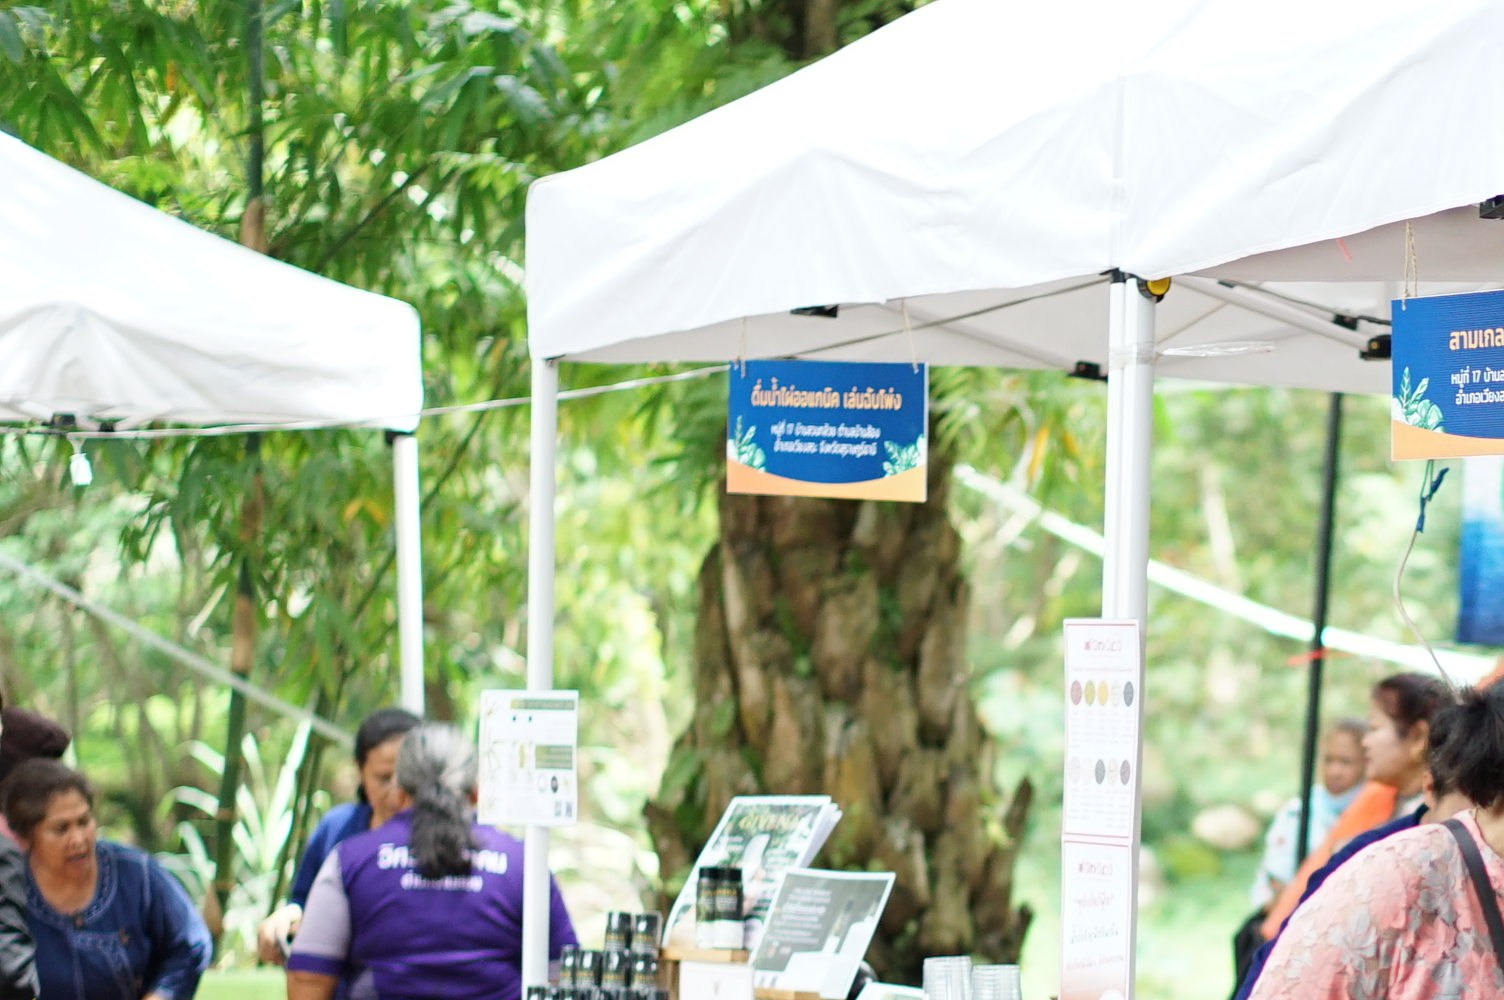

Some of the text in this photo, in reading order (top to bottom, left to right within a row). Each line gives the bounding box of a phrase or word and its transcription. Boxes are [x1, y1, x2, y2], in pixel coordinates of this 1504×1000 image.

[1451, 366, 1470, 387] หมู่ที่
[1472, 370, 1481, 384] 17
